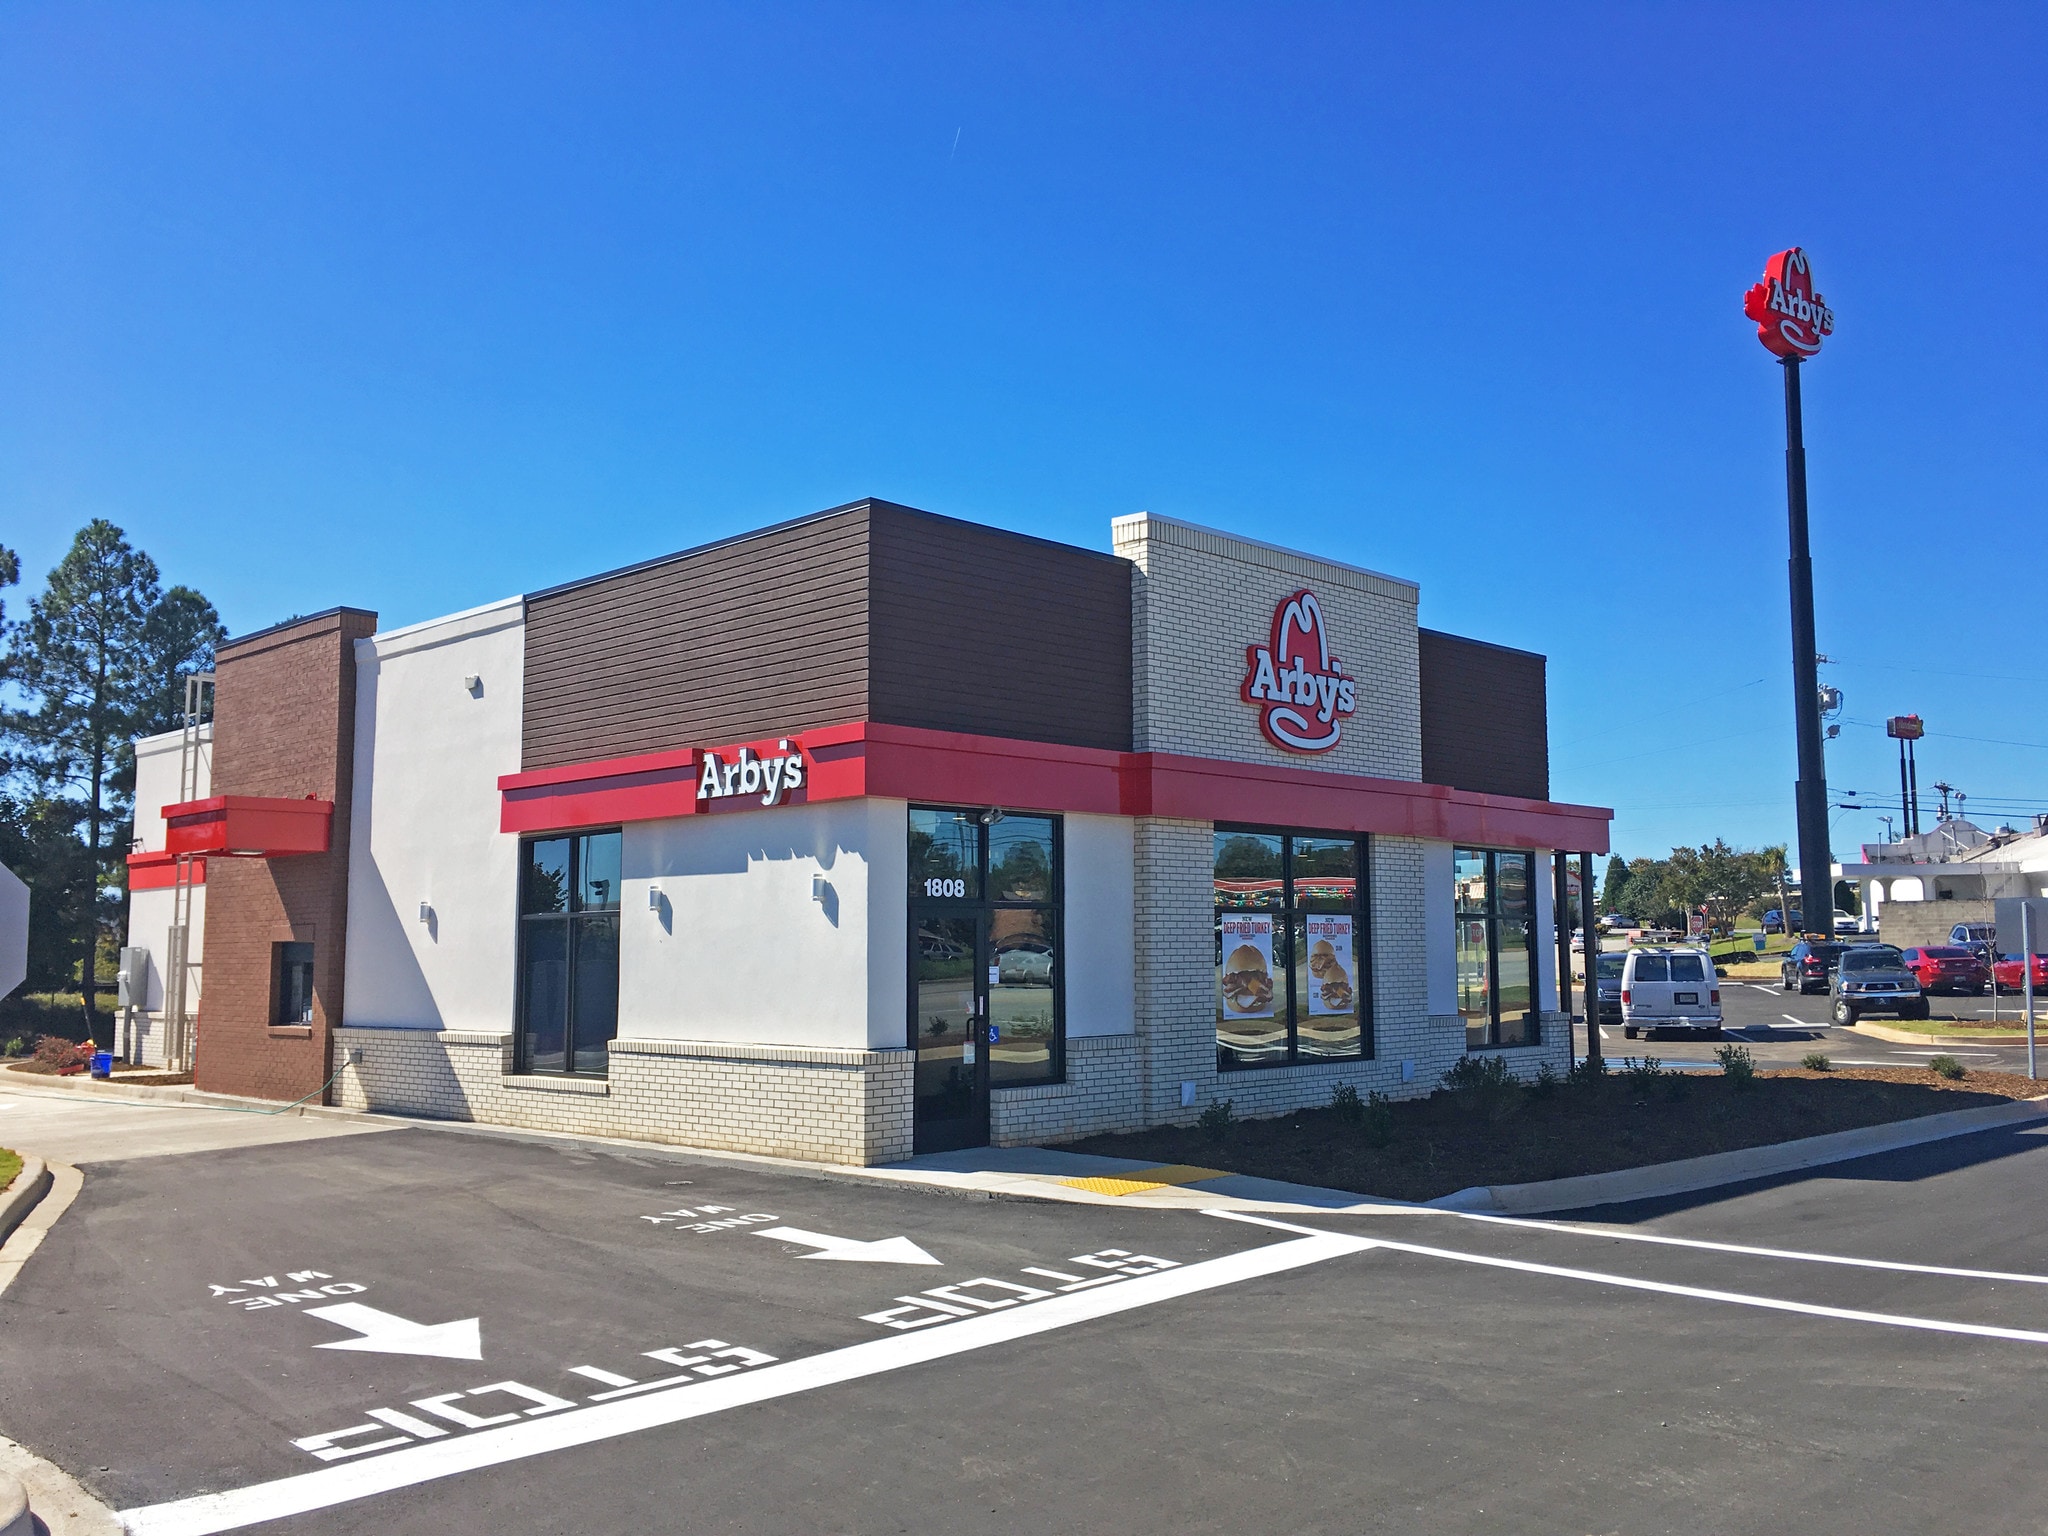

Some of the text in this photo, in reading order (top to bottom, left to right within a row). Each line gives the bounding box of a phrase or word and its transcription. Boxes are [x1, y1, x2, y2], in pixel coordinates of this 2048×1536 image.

[1771, 279, 1834, 335] Arby's
[1250, 649, 1355, 723] Arby's
[697, 739, 802, 806] Arby's
[924, 878, 965, 898] 1808
[1224, 922, 1270, 934] DEEP FRIED TURKEY
[1309, 923, 1319, 934] DEEP
[639, 1205, 736, 1224] WAY
[675, 1213, 779, 1233] ONE
[208, 1270, 333, 1297] WAY
[227, 1282, 368, 1310] ONE
[858, 1249, 1183, 1329] STOP
[289, 1339, 779, 1461] STOP
